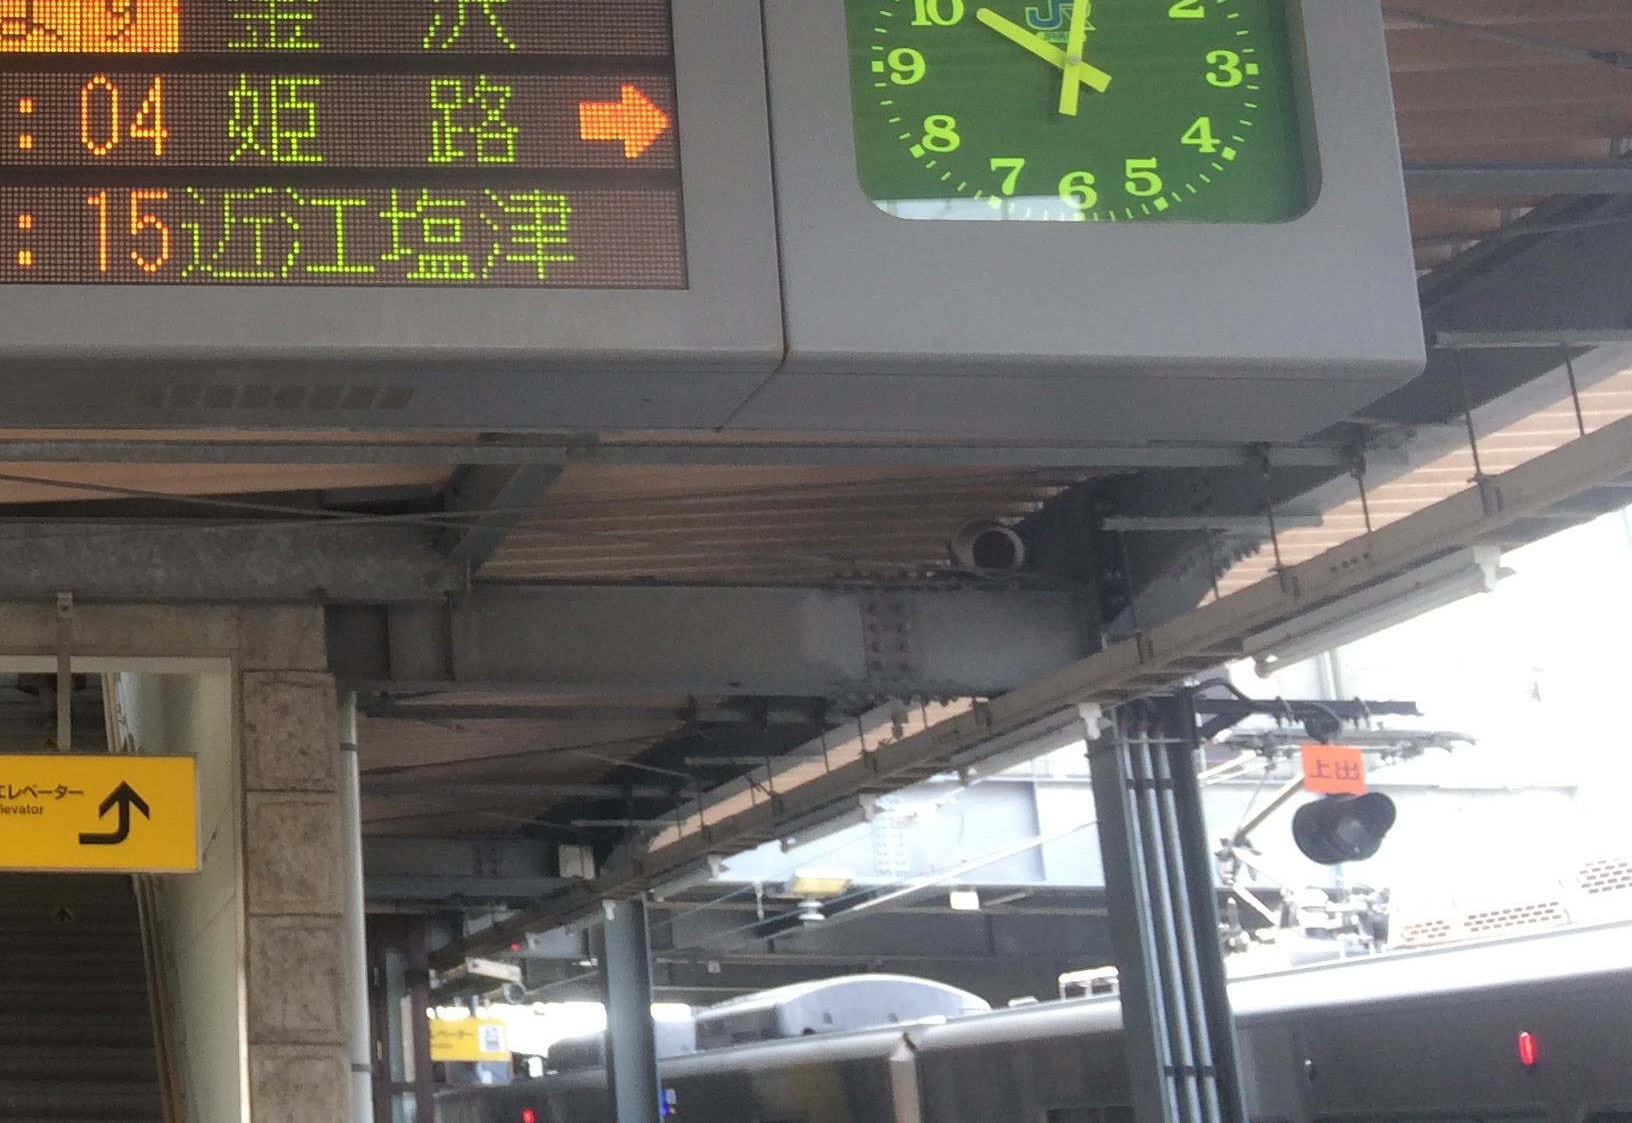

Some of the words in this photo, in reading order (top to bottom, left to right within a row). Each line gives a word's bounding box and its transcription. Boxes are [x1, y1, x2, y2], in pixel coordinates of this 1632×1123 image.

[887, 47, 926, 86] 9
[1205, 50, 1243, 87] 3
[921, 114, 961, 153] 8
[1180, 116, 1221, 154] 4
[989, 157, 1026, 195] 7
[1058, 171, 1098, 210] 6
[1124, 157, 1163, 197] 5
[180, 187, 574, 280] 近江塩津
